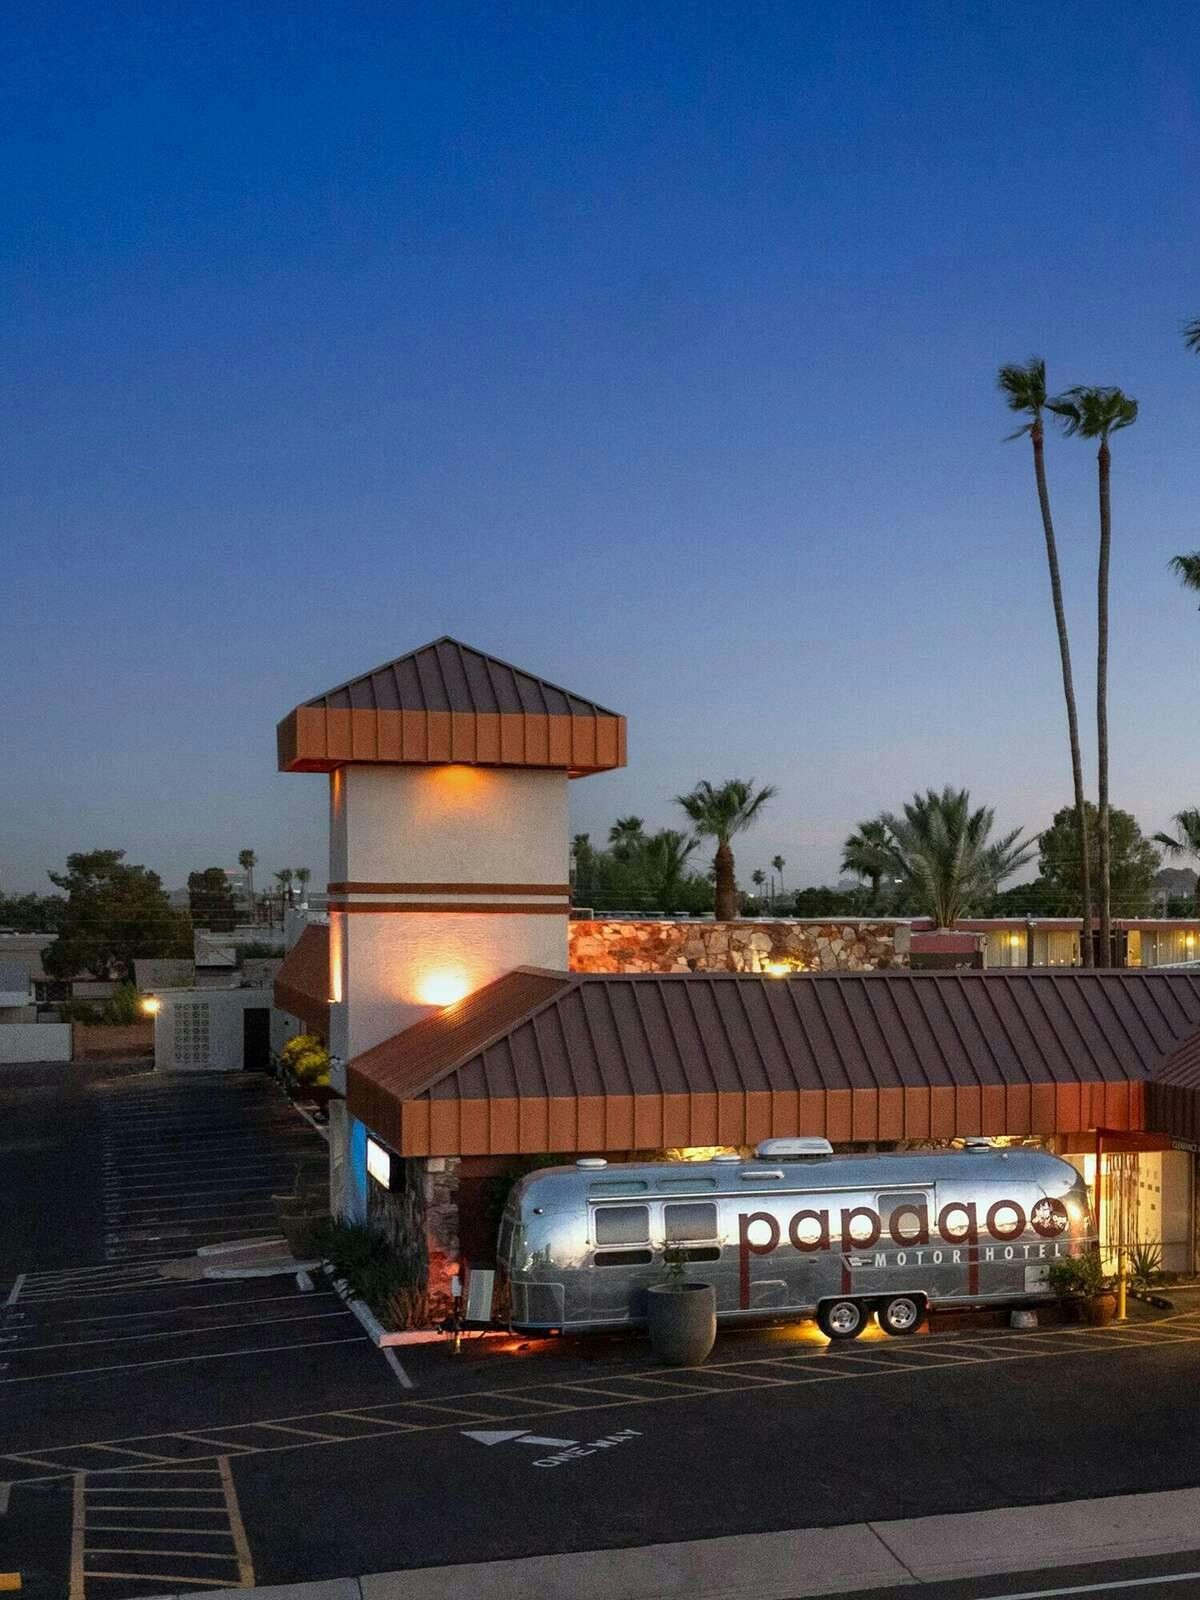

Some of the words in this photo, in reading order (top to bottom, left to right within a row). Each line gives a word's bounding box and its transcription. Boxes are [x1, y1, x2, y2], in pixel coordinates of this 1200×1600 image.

[738, 1199, 1027, 1310] papago
[874, 1250, 962, 1268] MOTOR
[985, 1246, 1063, 1263] HOTEL
[532, 1447, 597, 1467] ONE
[586, 1429, 643, 1448] WAY
